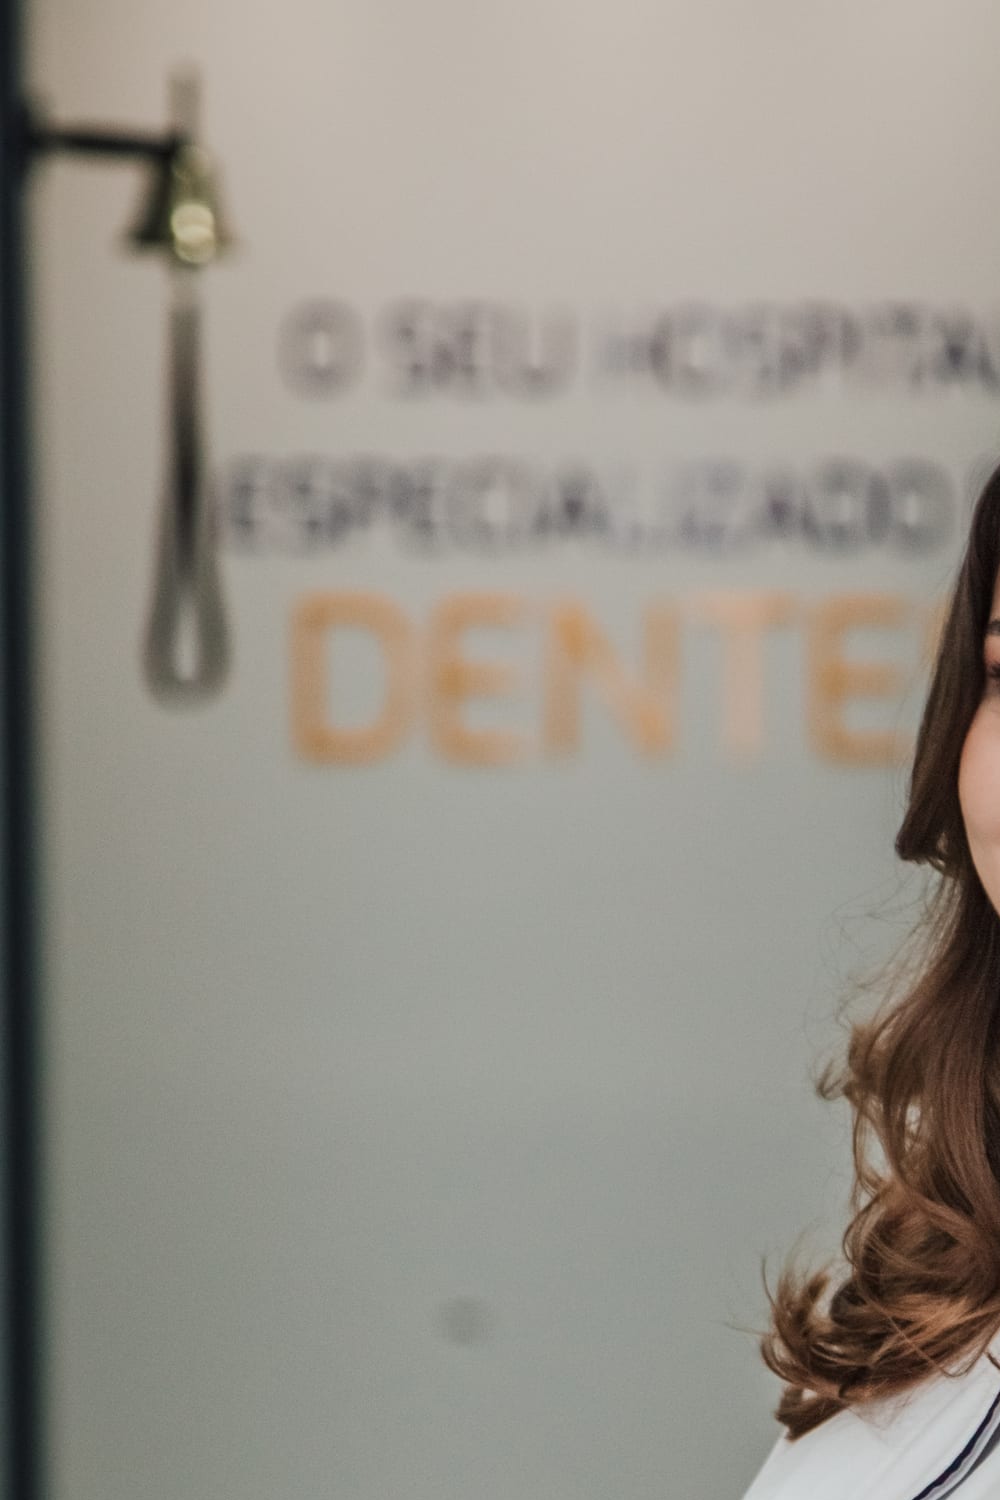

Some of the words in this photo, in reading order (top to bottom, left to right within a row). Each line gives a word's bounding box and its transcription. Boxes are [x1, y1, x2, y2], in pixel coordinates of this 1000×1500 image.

[278, 298, 366, 397] O
[378, 298, 588, 397] SEU
[225, 455, 958, 560] ESPECIALIZADO
[286, 588, 940, 768] DENTE
